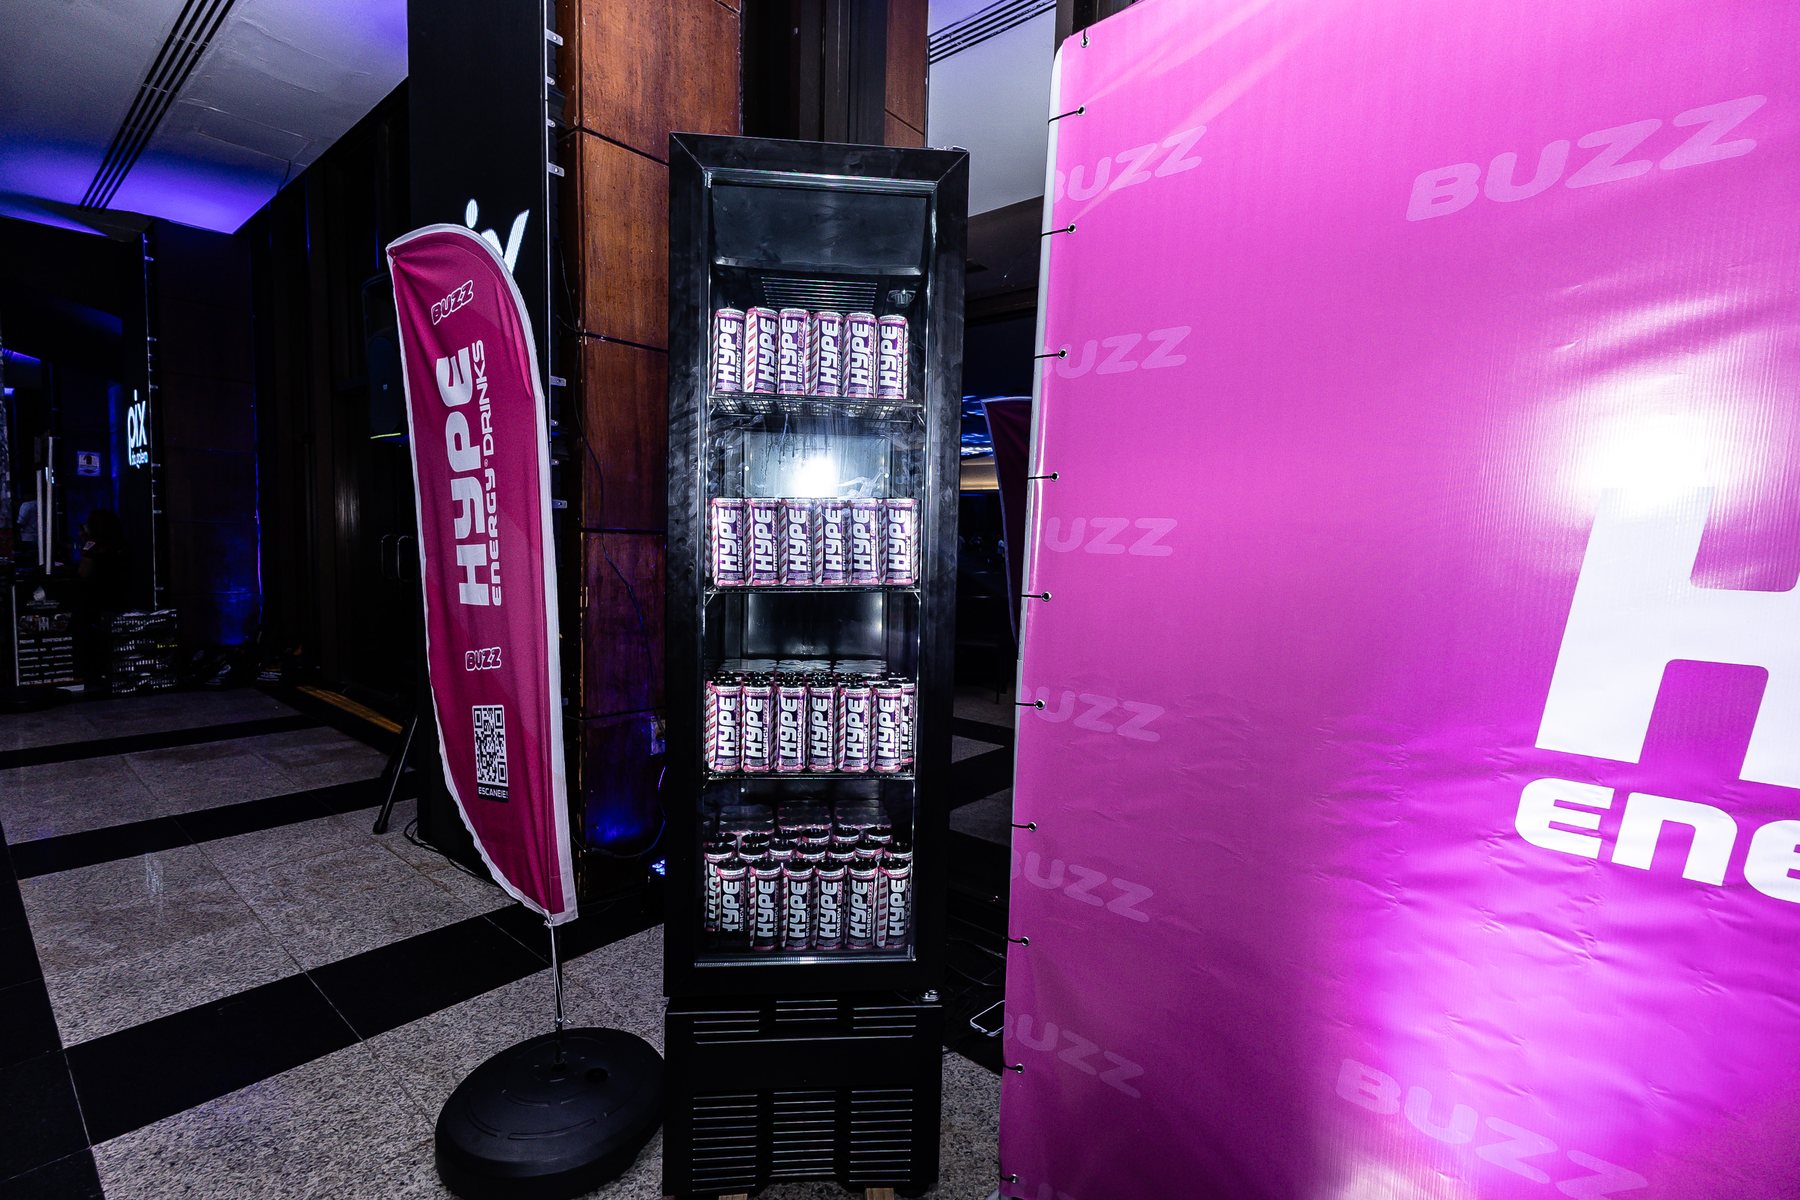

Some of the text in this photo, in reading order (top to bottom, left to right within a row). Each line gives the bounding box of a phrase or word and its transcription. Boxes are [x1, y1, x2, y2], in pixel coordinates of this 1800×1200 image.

[1405, 94, 1768, 222] BUZZ
[430, 279, 475, 326] BUZZ
[717, 318, 737, 382] HYPE
[758, 317, 776, 383] HYPE
[780, 318, 798, 382] HYPE
[820, 320, 839, 385] HYPE
[851, 322, 870, 385] HYPE
[880, 325, 898, 387] HYPE
[1042, 325, 1192, 380] UZZ
[127, 389, 148, 466] pix
[472, 339, 495, 456] DRINKS
[435, 346, 490, 606] HYPE
[718, 507, 738, 571] HYPE
[754, 508, 773, 571] HYPE
[788, 508, 807, 571] HYPE
[825, 508, 843, 571] HYPE
[852, 508, 871, 571] HYPE
[888, 508, 907, 571] HYPE
[465, 646, 502, 672] BUZZ
[717, 696, 737, 757] HYPE
[745, 696, 763, 758] HYPE
[780, 697, 797, 757] HYPE
[811, 697, 828, 757] HYPE
[846, 698, 864, 758] HYPE
[878, 698, 896, 758] HYPE
[757, 880, 775, 938] HYPE
[789, 881, 807, 938] HYPE
[819, 881, 838, 938] HYPE
[850, 880, 868, 938] HYPE
[889, 880, 906, 936] HYPE
[1335, 1058, 1649, 1200] BUZZ
